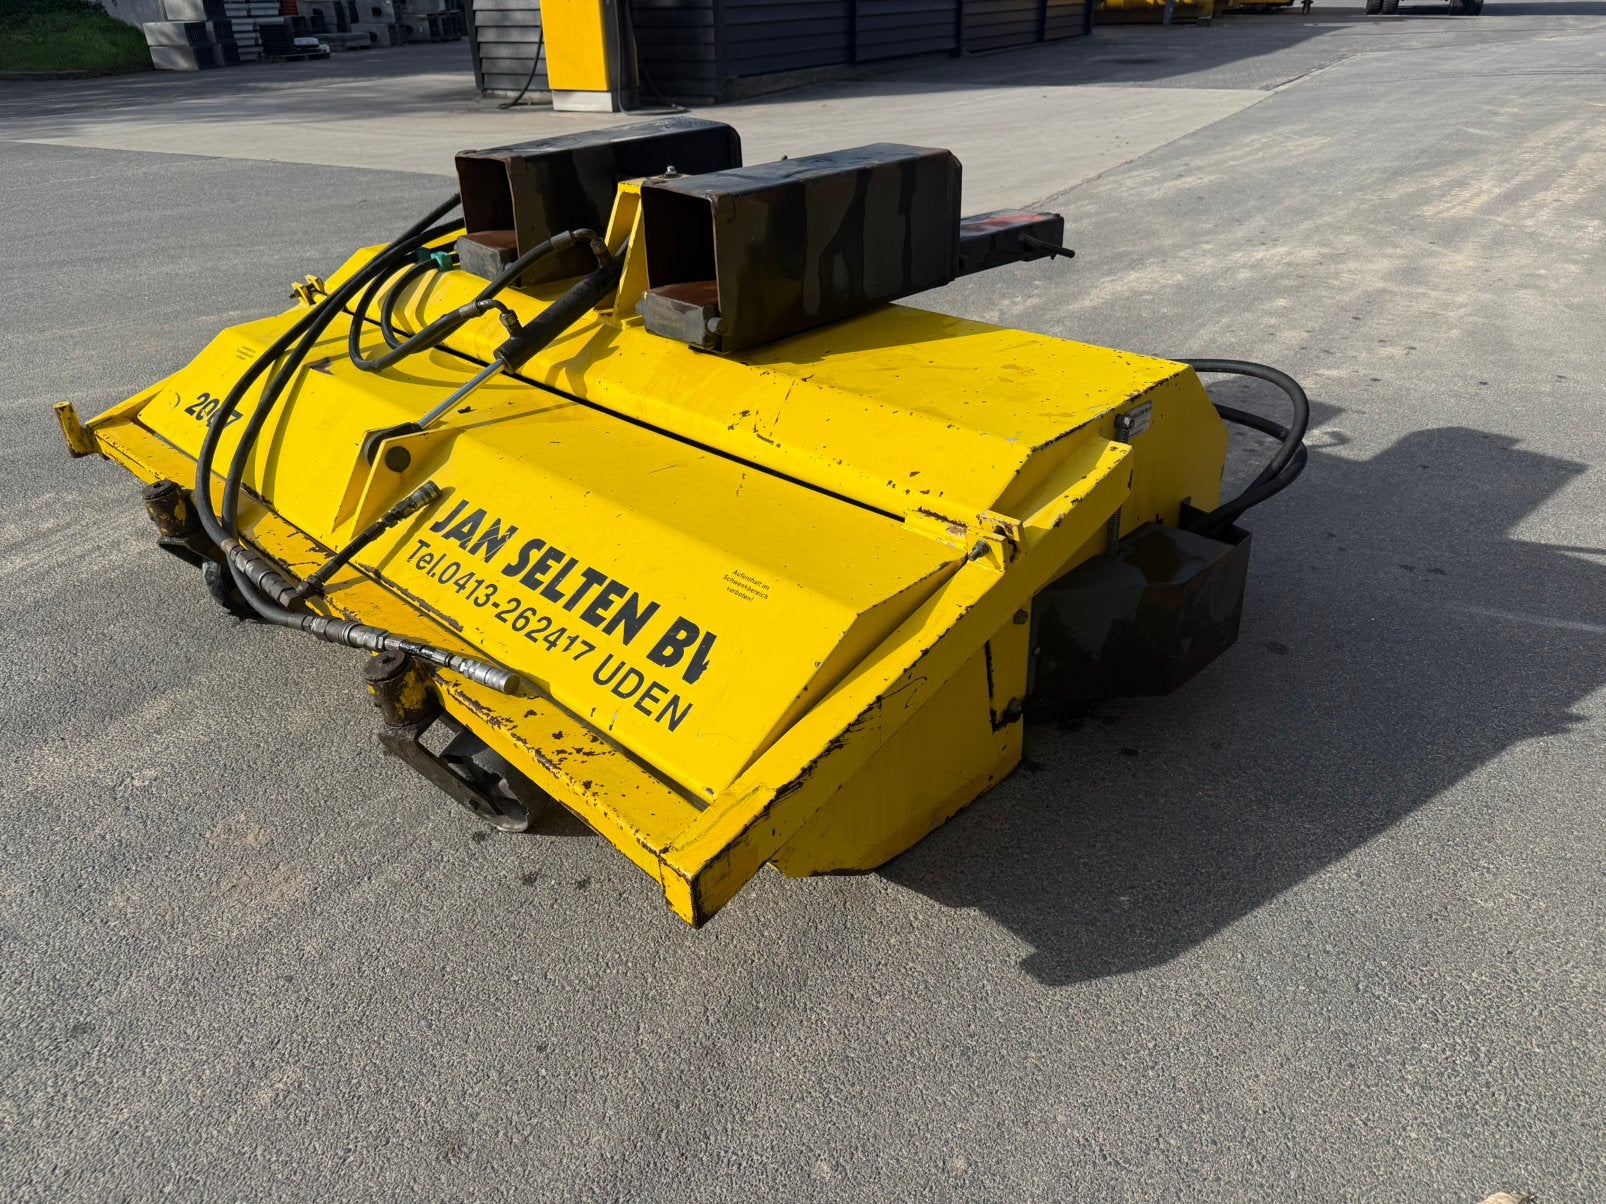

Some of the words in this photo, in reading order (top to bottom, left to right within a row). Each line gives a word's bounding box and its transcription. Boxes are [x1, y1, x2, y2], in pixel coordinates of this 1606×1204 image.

[184, 392, 243, 429] 207
[406, 539, 596, 662] Tel.0413-262417
[593, 654, 693, 733] UDEN
[429, 500, 518, 563] JAN
[502, 538, 661, 647] SELTEN
